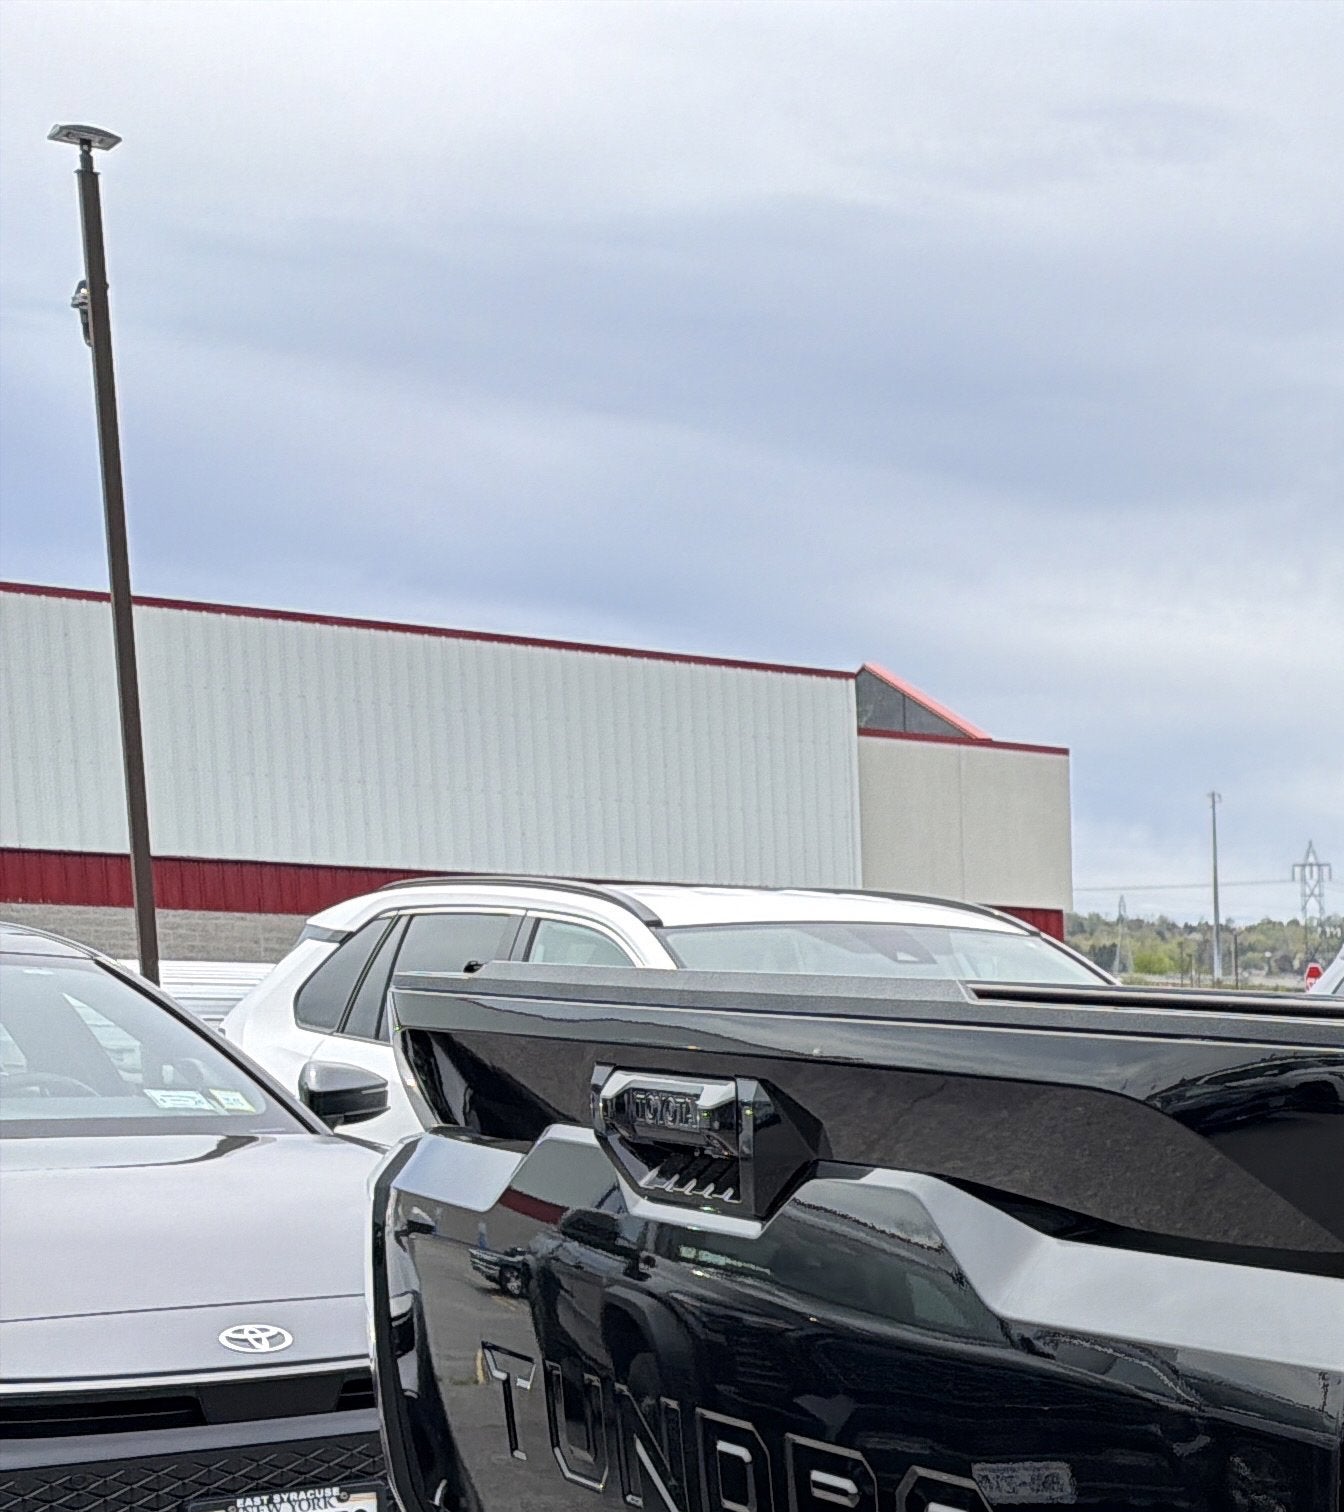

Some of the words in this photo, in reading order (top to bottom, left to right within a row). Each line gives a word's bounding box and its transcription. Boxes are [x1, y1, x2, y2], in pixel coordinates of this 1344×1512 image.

[632, 1090, 701, 1131] TOYOTA
[236, 1495, 270, 1508] EAST
[272, 1486, 341, 1504] SYRACUSE
